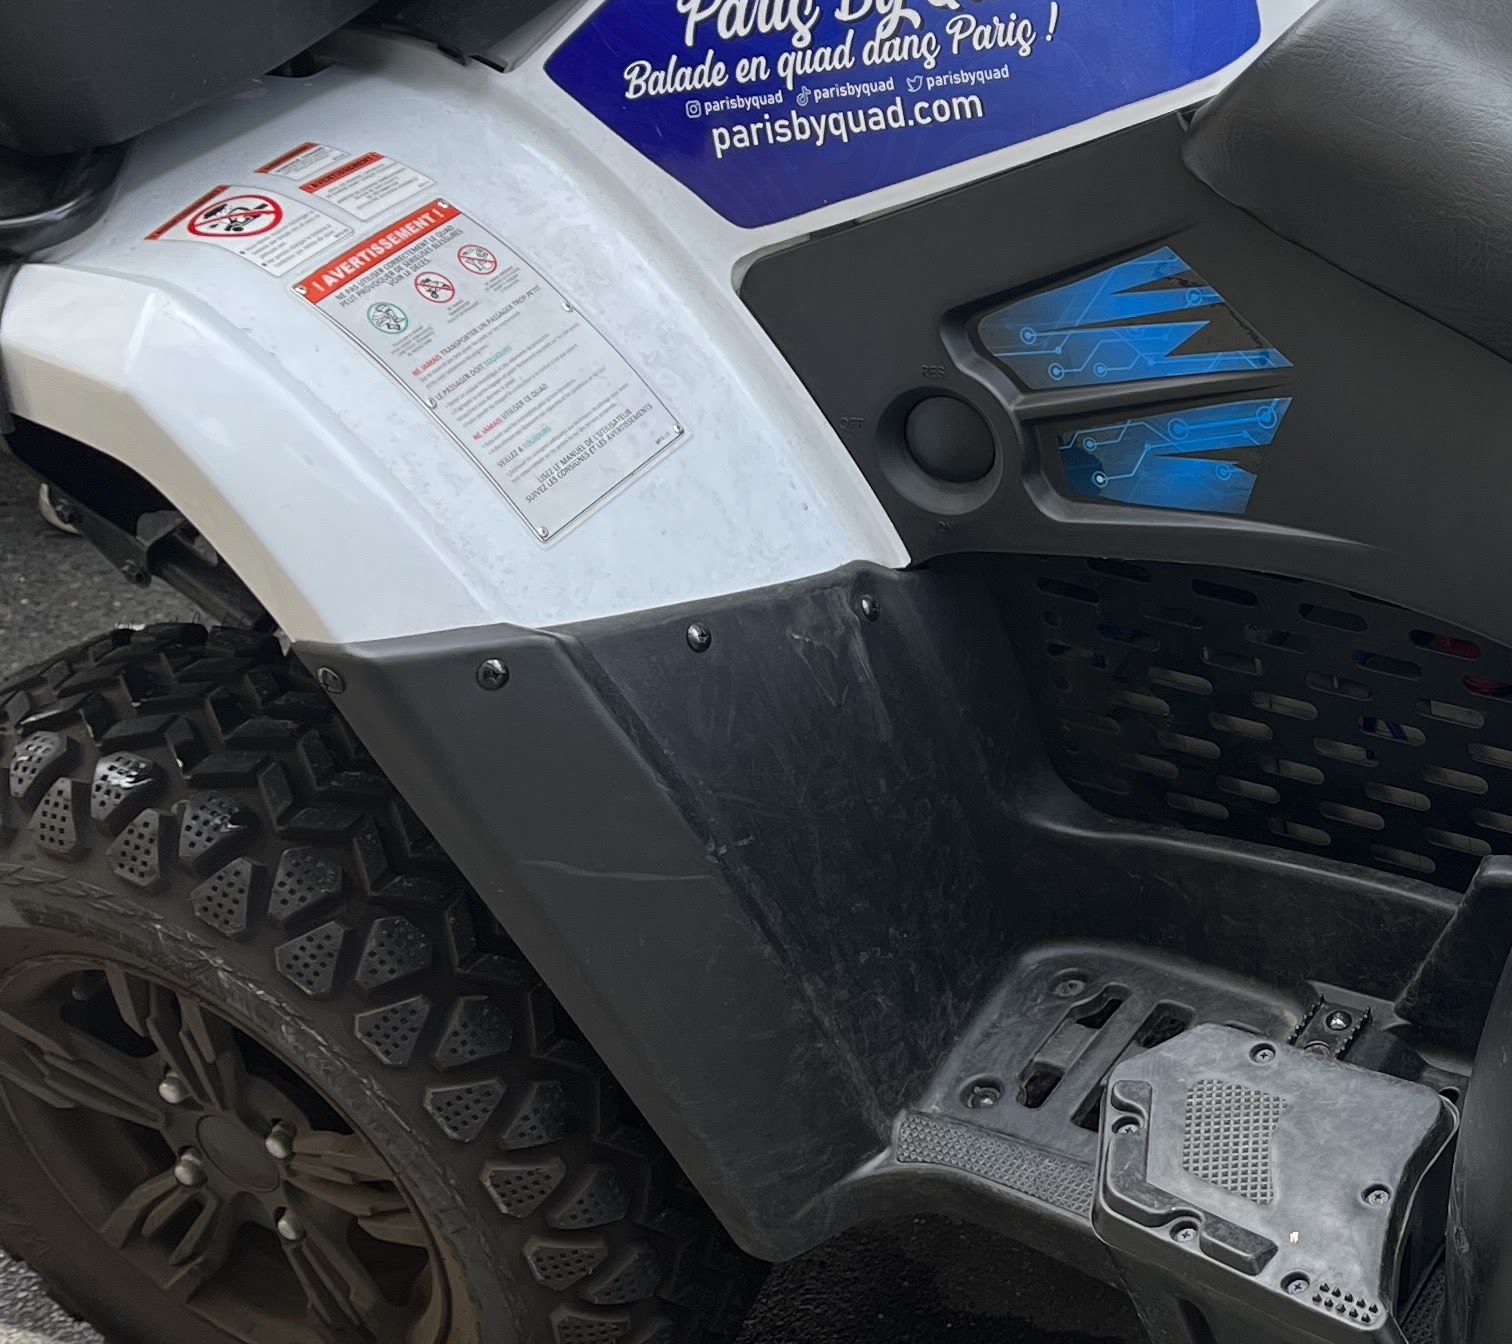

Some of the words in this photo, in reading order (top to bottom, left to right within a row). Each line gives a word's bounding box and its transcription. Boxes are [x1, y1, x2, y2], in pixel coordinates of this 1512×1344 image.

[623, 54, 728, 100] Balade
[736, 58, 770, 82] en
[776, 31, 854, 90] quad
[863, 23, 941, 70] dans
[945, 12, 1037, 56] Paris
[703, 90, 784, 115] parisbyquad
[813, 76, 895, 102] parisbyquad
[926, 64, 1011, 91] parisbyquad
[711, 93, 985, 158] parisbyquad.com
[319, 212, 438, 286] AVERTISSEMENT
